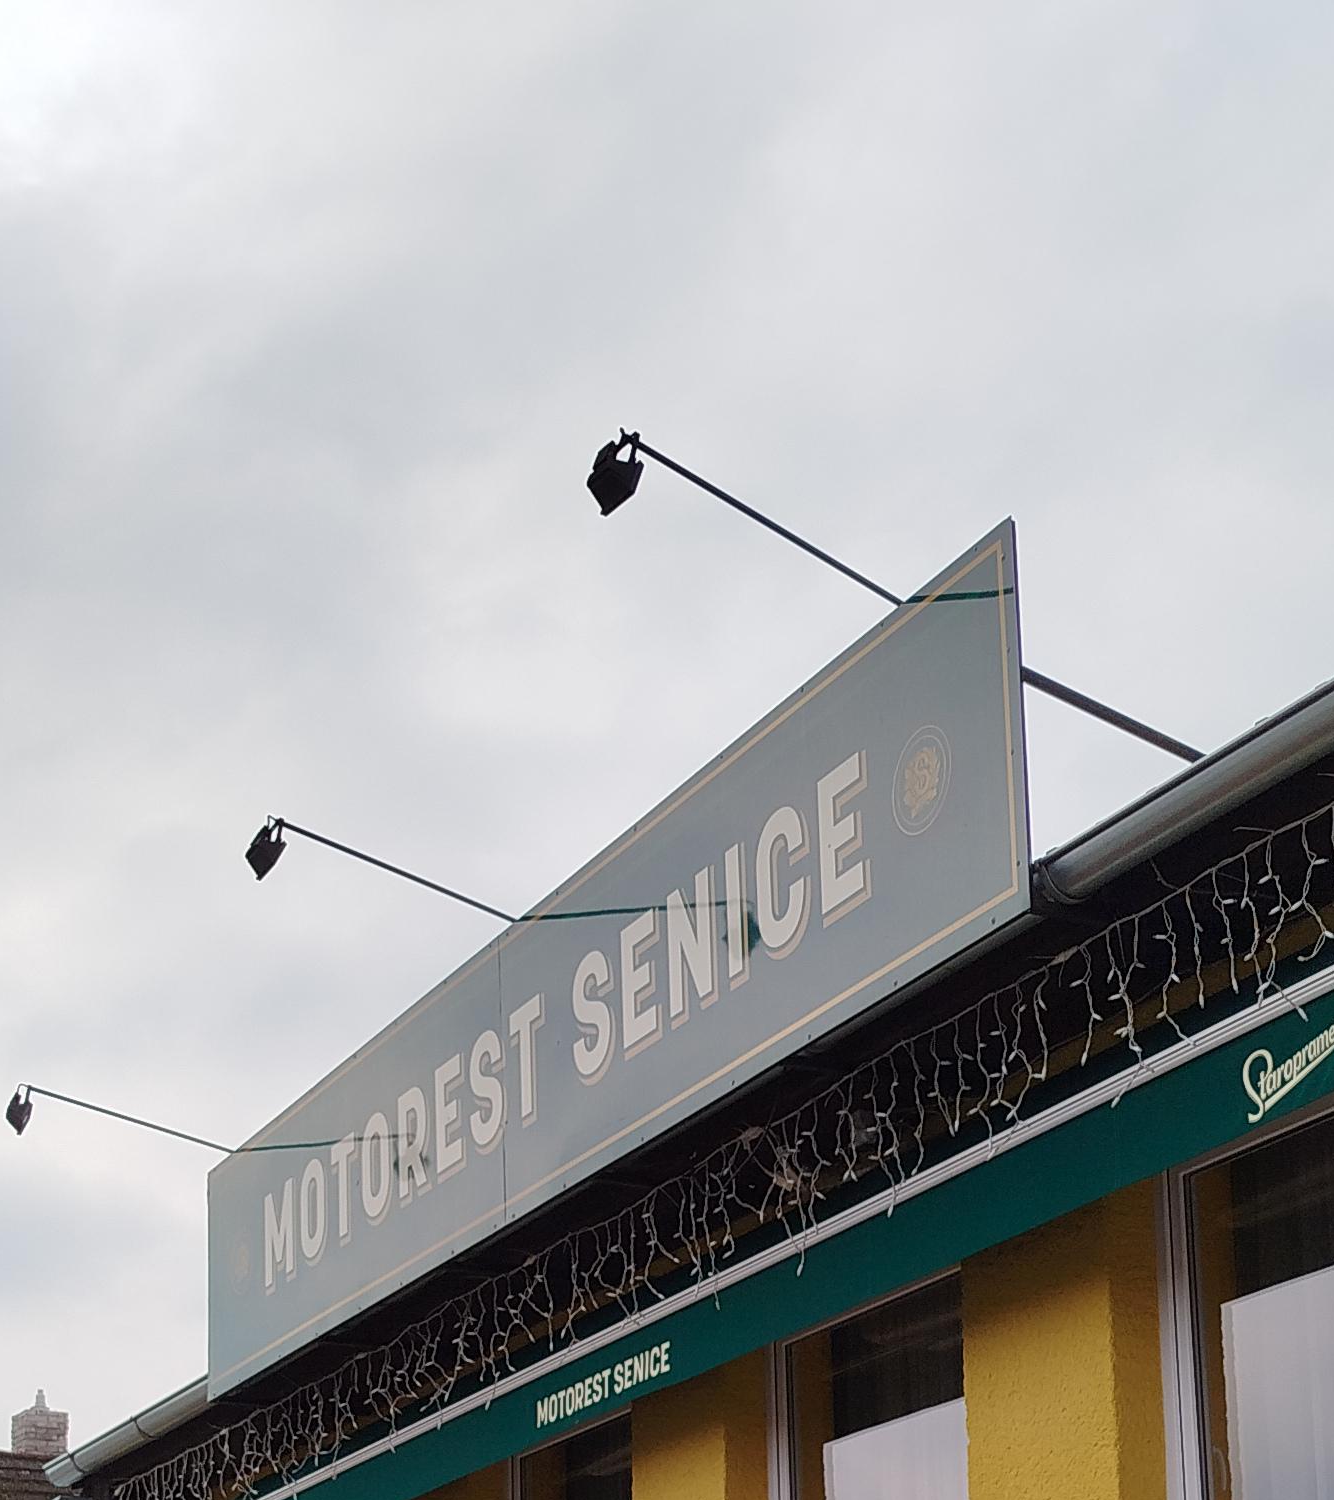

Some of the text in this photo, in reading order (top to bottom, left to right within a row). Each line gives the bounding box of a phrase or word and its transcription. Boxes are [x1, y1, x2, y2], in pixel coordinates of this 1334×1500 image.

[262, 750, 872, 1296] MOTOREST SENICE
[536, 1341, 671, 1429] MOTOREST SENICE
